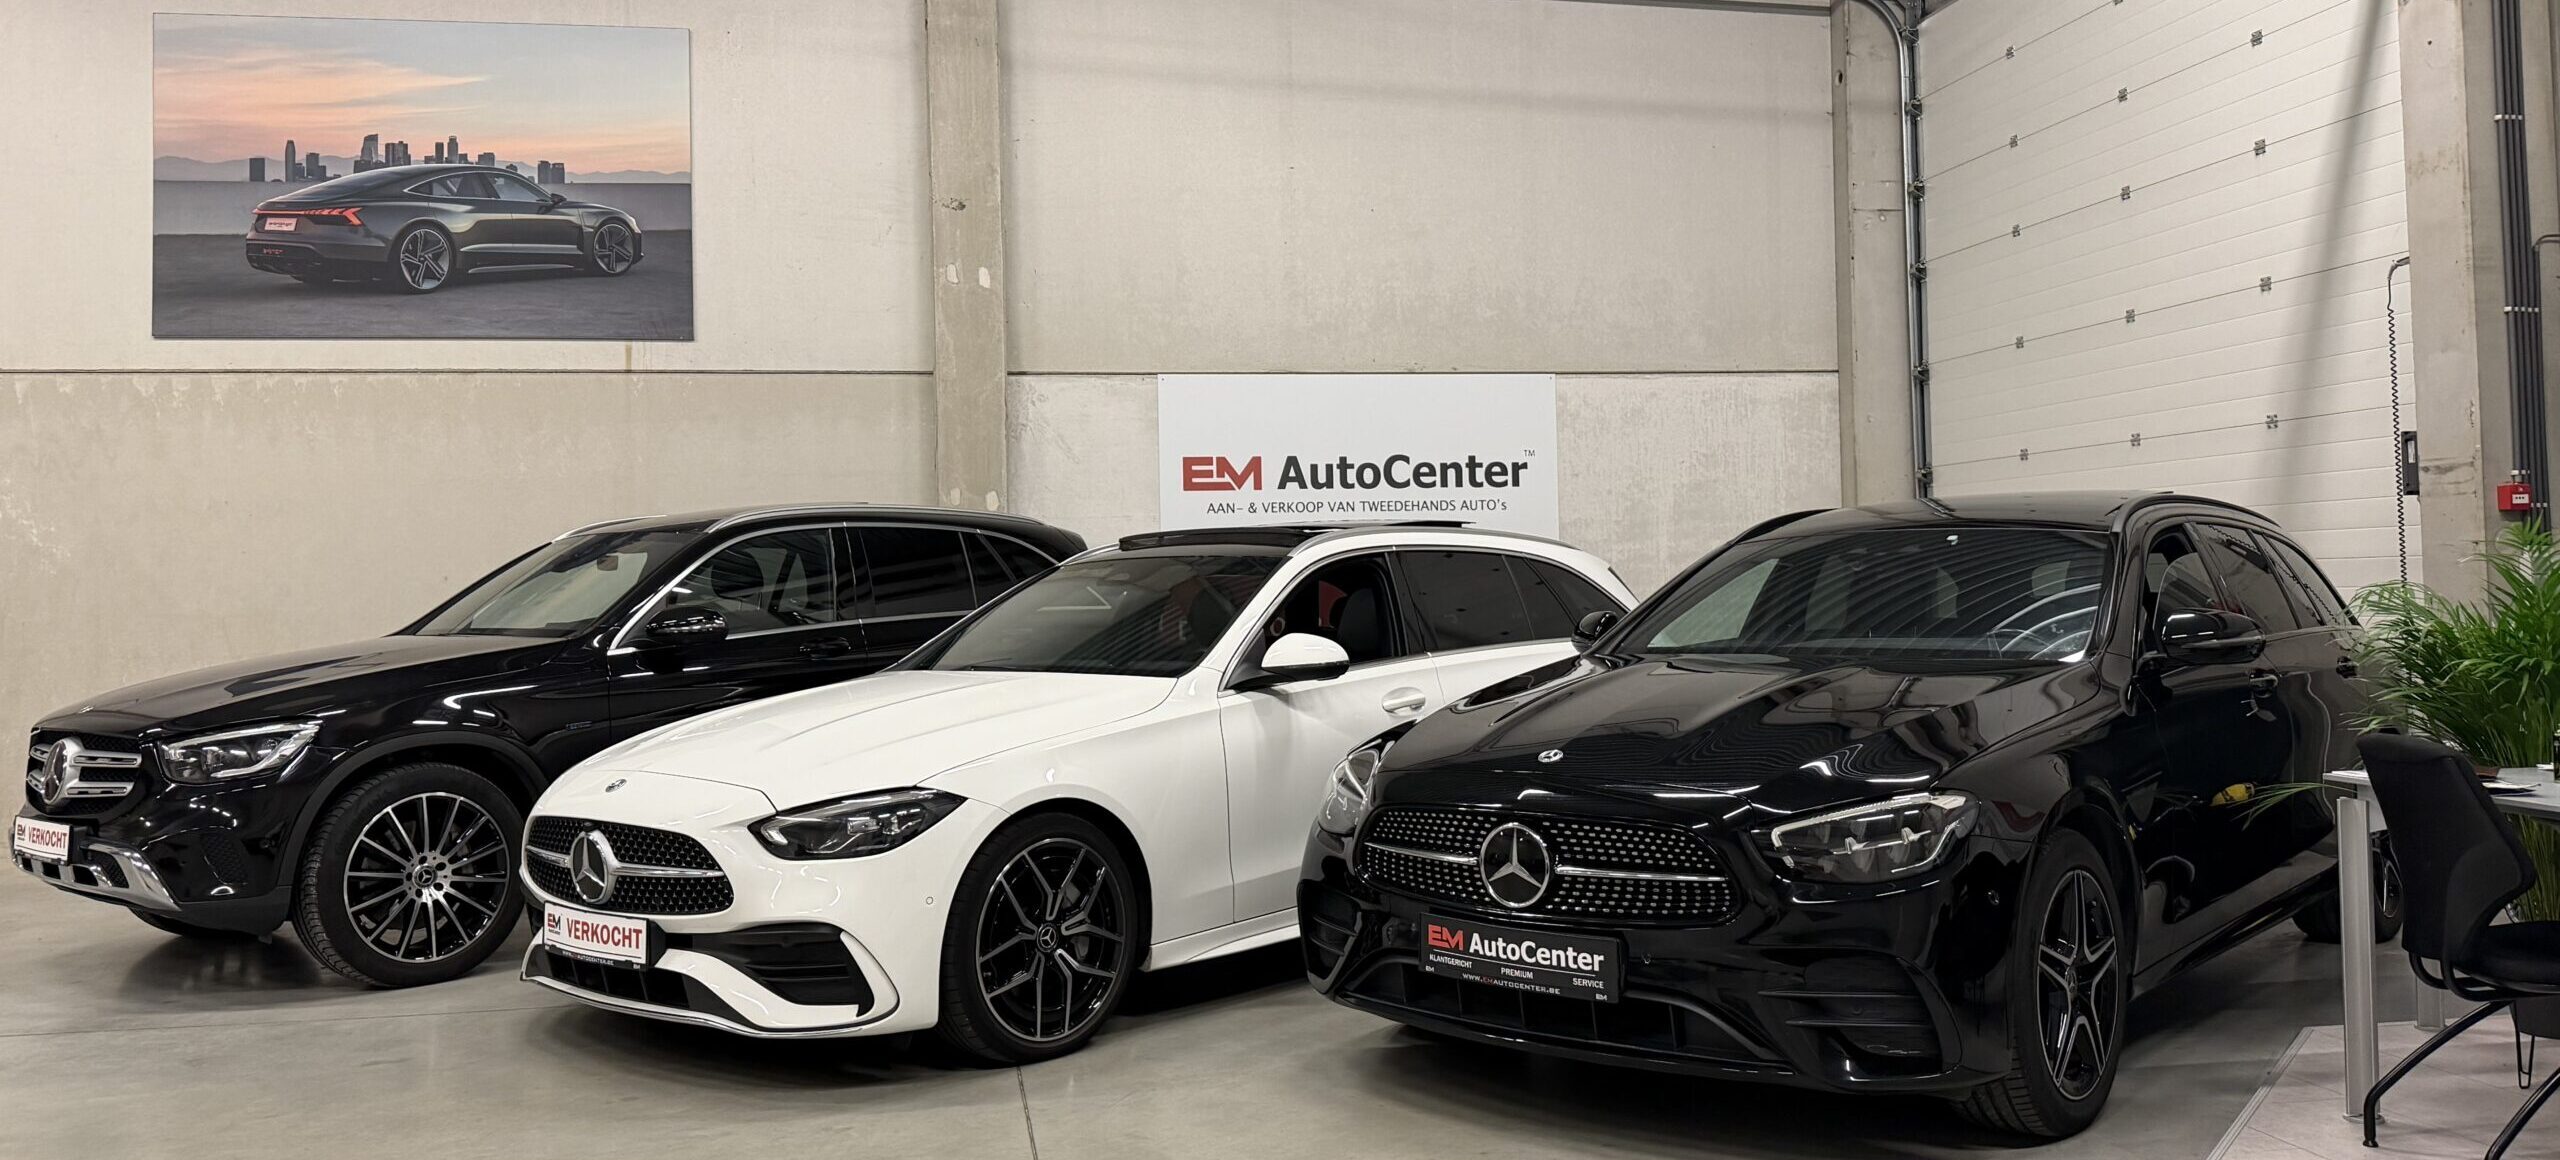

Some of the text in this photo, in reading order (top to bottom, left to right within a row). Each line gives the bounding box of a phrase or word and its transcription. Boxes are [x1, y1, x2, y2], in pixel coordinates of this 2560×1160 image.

[1182, 456, 1263, 491] EM
[1277, 454, 1529, 490] AutoCenter
[1206, 498, 1508, 514] AAN- & VERKOOP VAN TWEEDEHANDS AUTO's
[28, 826, 67, 849] VERKOCHT
[547, 913, 643, 949] EM VERKOCHT
[1428, 924, 1604, 972] EM AutoCenter
[1429, 954, 1604, 989] KLANTGERICHT PREMIUM SERVICE
